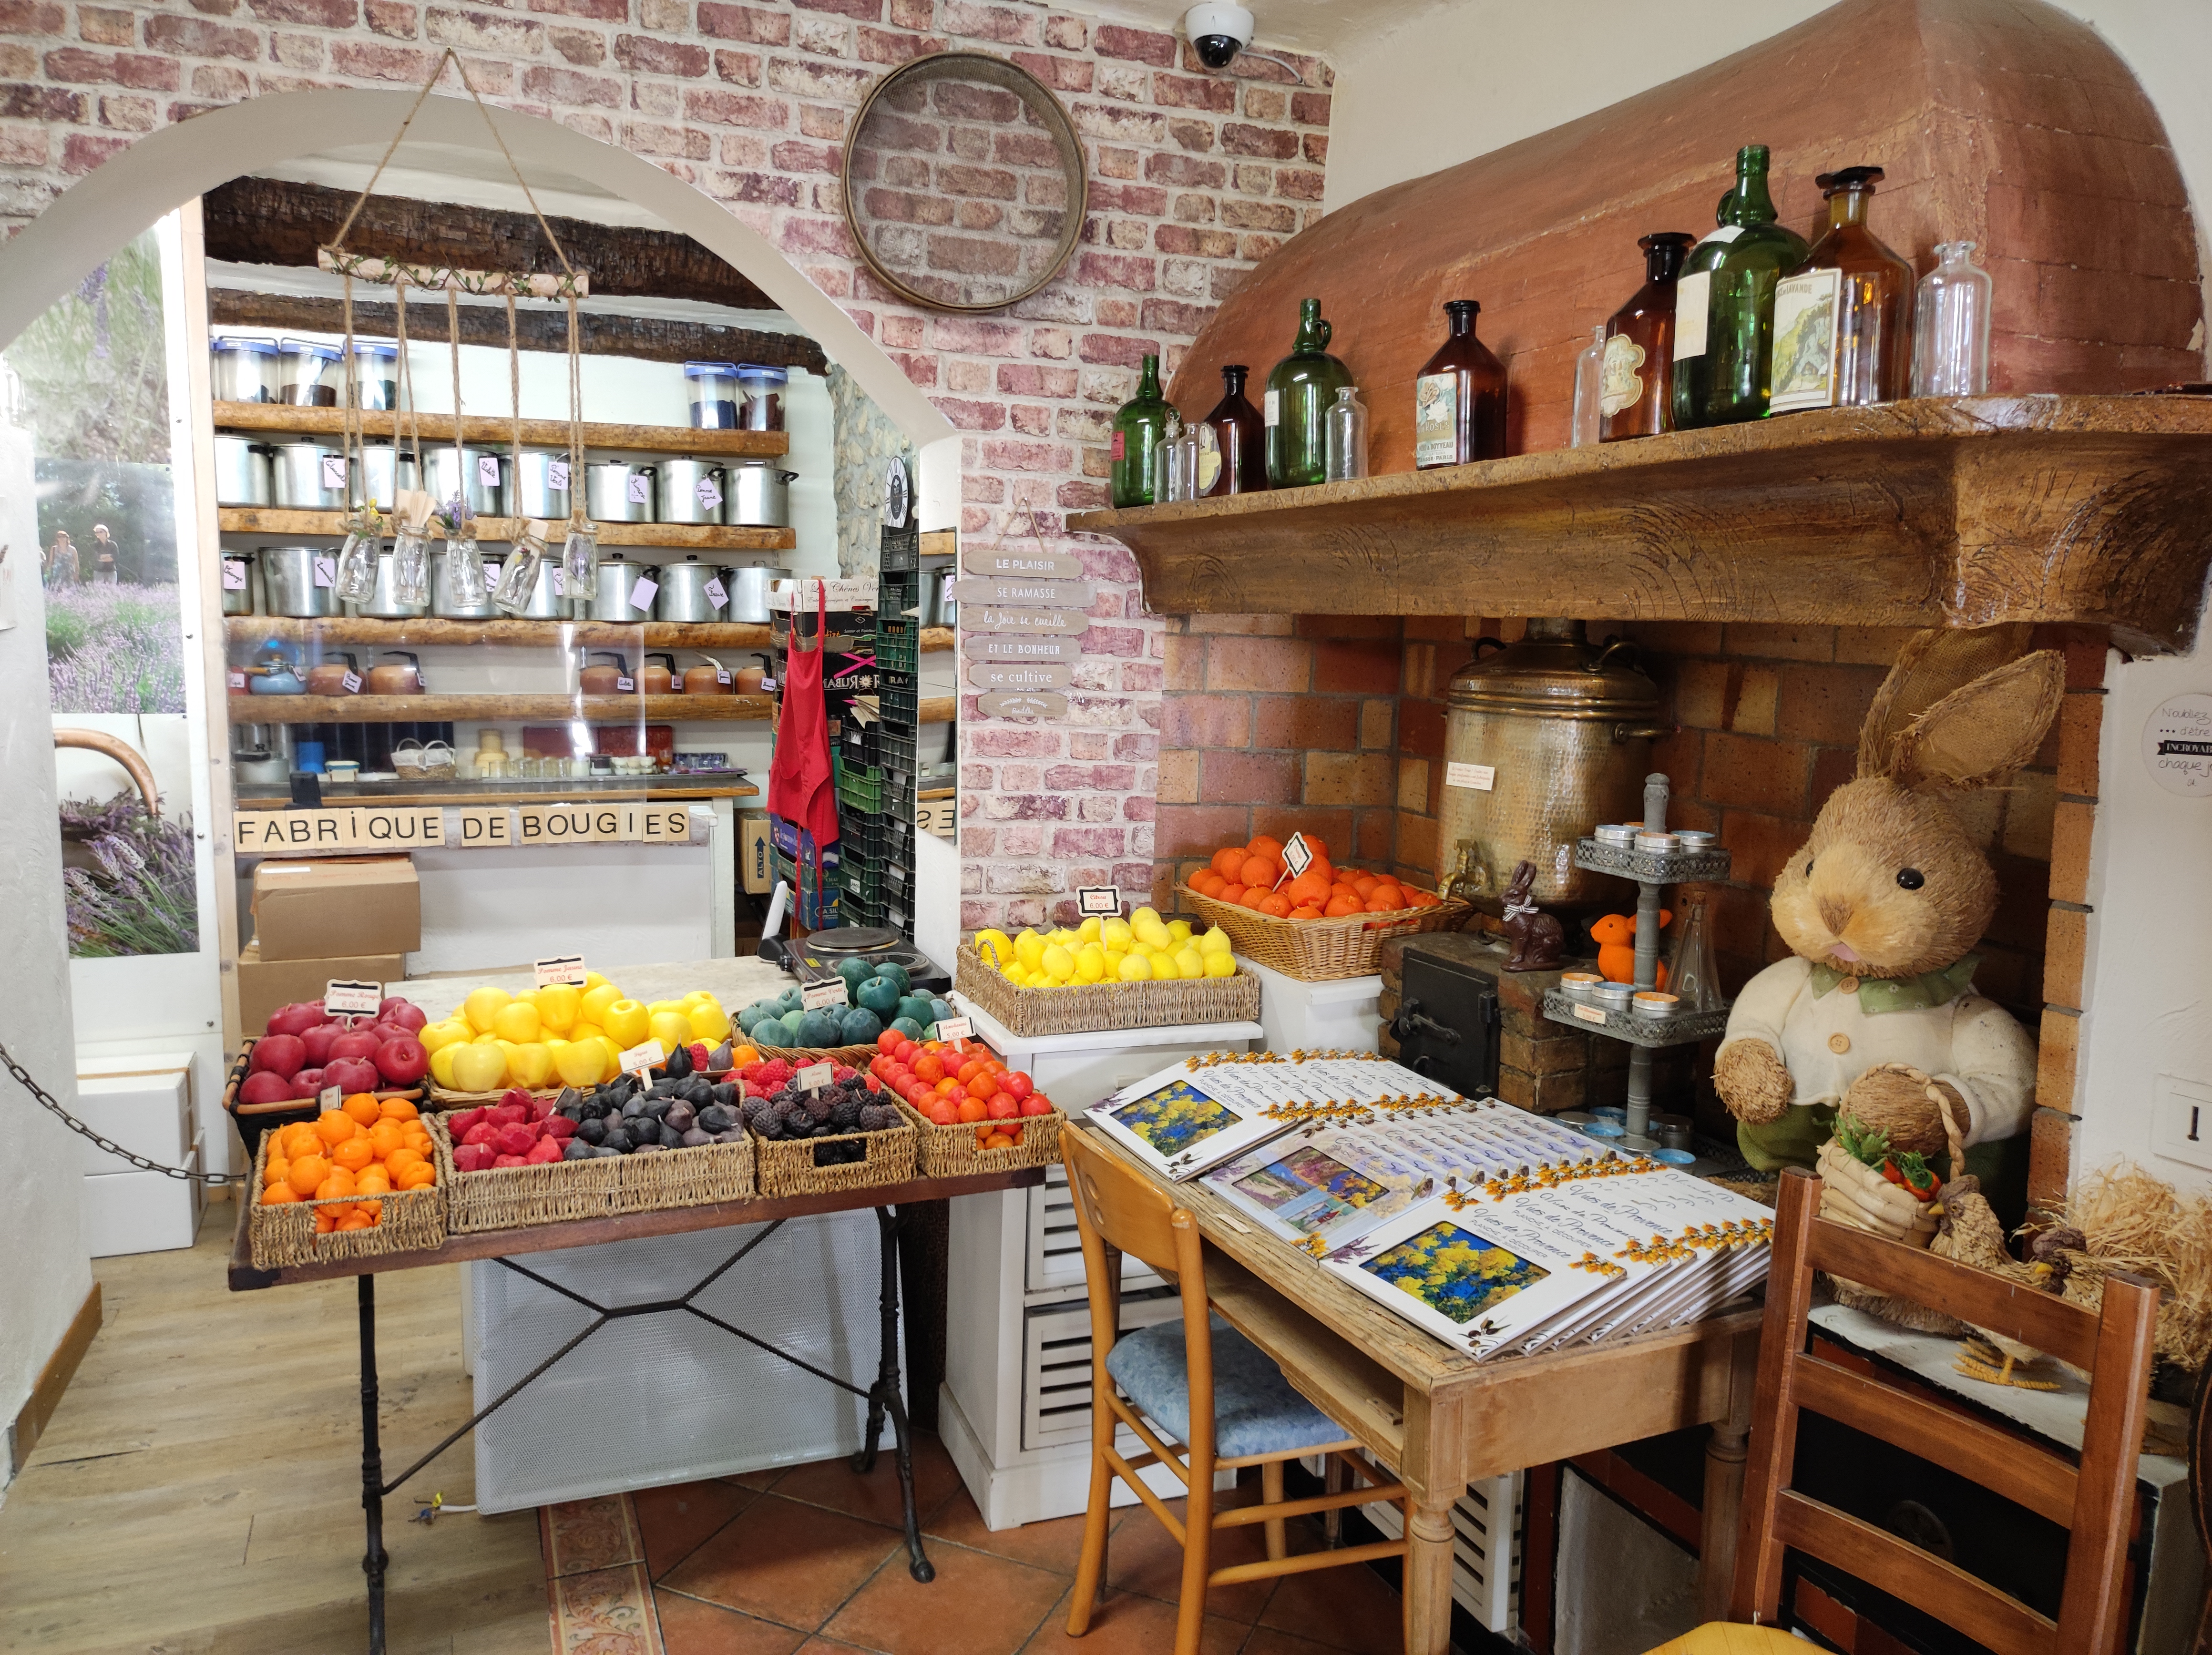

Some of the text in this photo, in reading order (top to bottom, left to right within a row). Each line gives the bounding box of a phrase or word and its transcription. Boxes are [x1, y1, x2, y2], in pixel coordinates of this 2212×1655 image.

[1787, 283, 1812, 294] LAVANDE
[1425, 421, 1450, 432] ROSES
[996, 559, 1055, 571] LE PLAISIR
[997, 587, 1056, 599] SE RAMASSE
[983, 610, 994, 623] la
[1020, 616, 1031, 625] se
[1034, 613, 1067, 627] cueille
[988, 644, 1060, 655] ET LE BONHEUR
[991, 671, 1053, 683] se cultive
[2158, 758, 2202, 776] chaque
[463, 817, 505, 839] DE
[523, 812, 686, 837] BOUGIES
[330, 990, 380, 1001] Pomme Rouge
[806, 991, 827, 1000] Pomme
[1202, 1070, 1222, 1083] Vues
[1227, 1086, 1261, 1109] Provence
[1569, 1185, 1600, 1204] Vues
[1614, 1205, 1673, 1234] Provence
[1516, 1197, 1546, 1216] Vues
[1557, 1218, 1615, 1247] Provence
[1474, 1208, 1504, 1226] Vues
[1515, 1229, 1571, 1258] Provence
